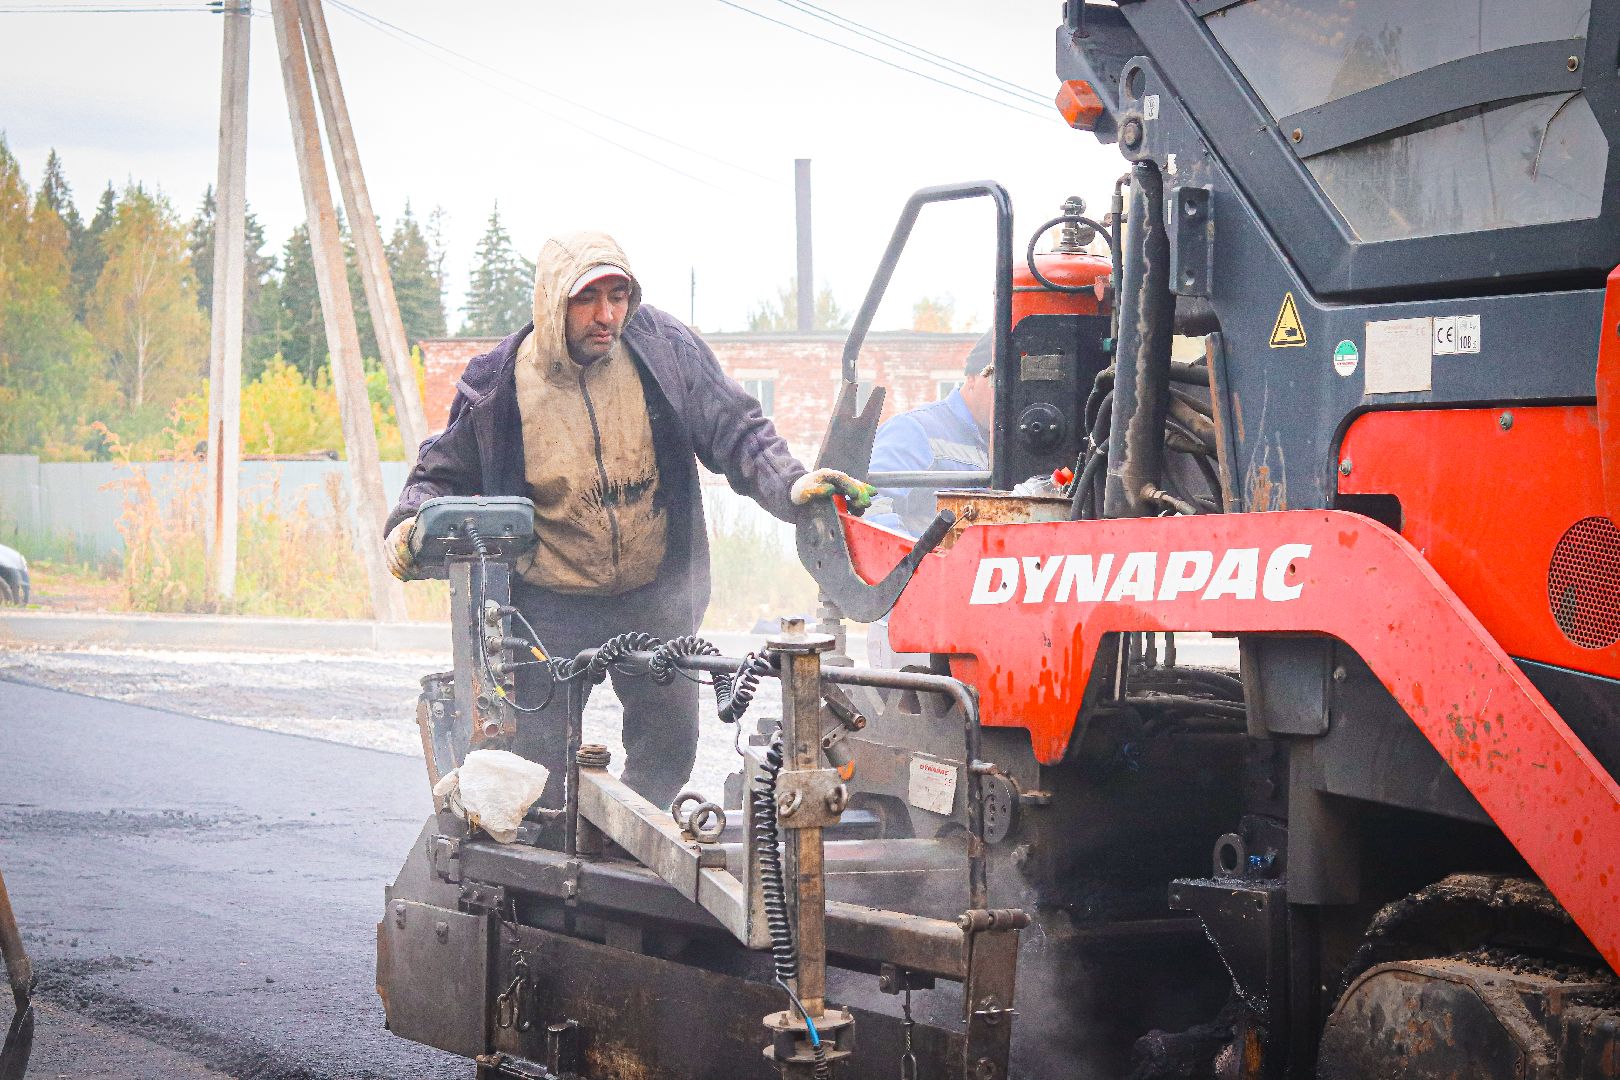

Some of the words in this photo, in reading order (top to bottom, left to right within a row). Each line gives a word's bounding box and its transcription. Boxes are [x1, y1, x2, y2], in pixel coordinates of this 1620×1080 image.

[1437, 326, 1453, 343] CE
[1460, 335, 1472, 349] 108
[968, 543, 1313, 605] DYNAPAC
